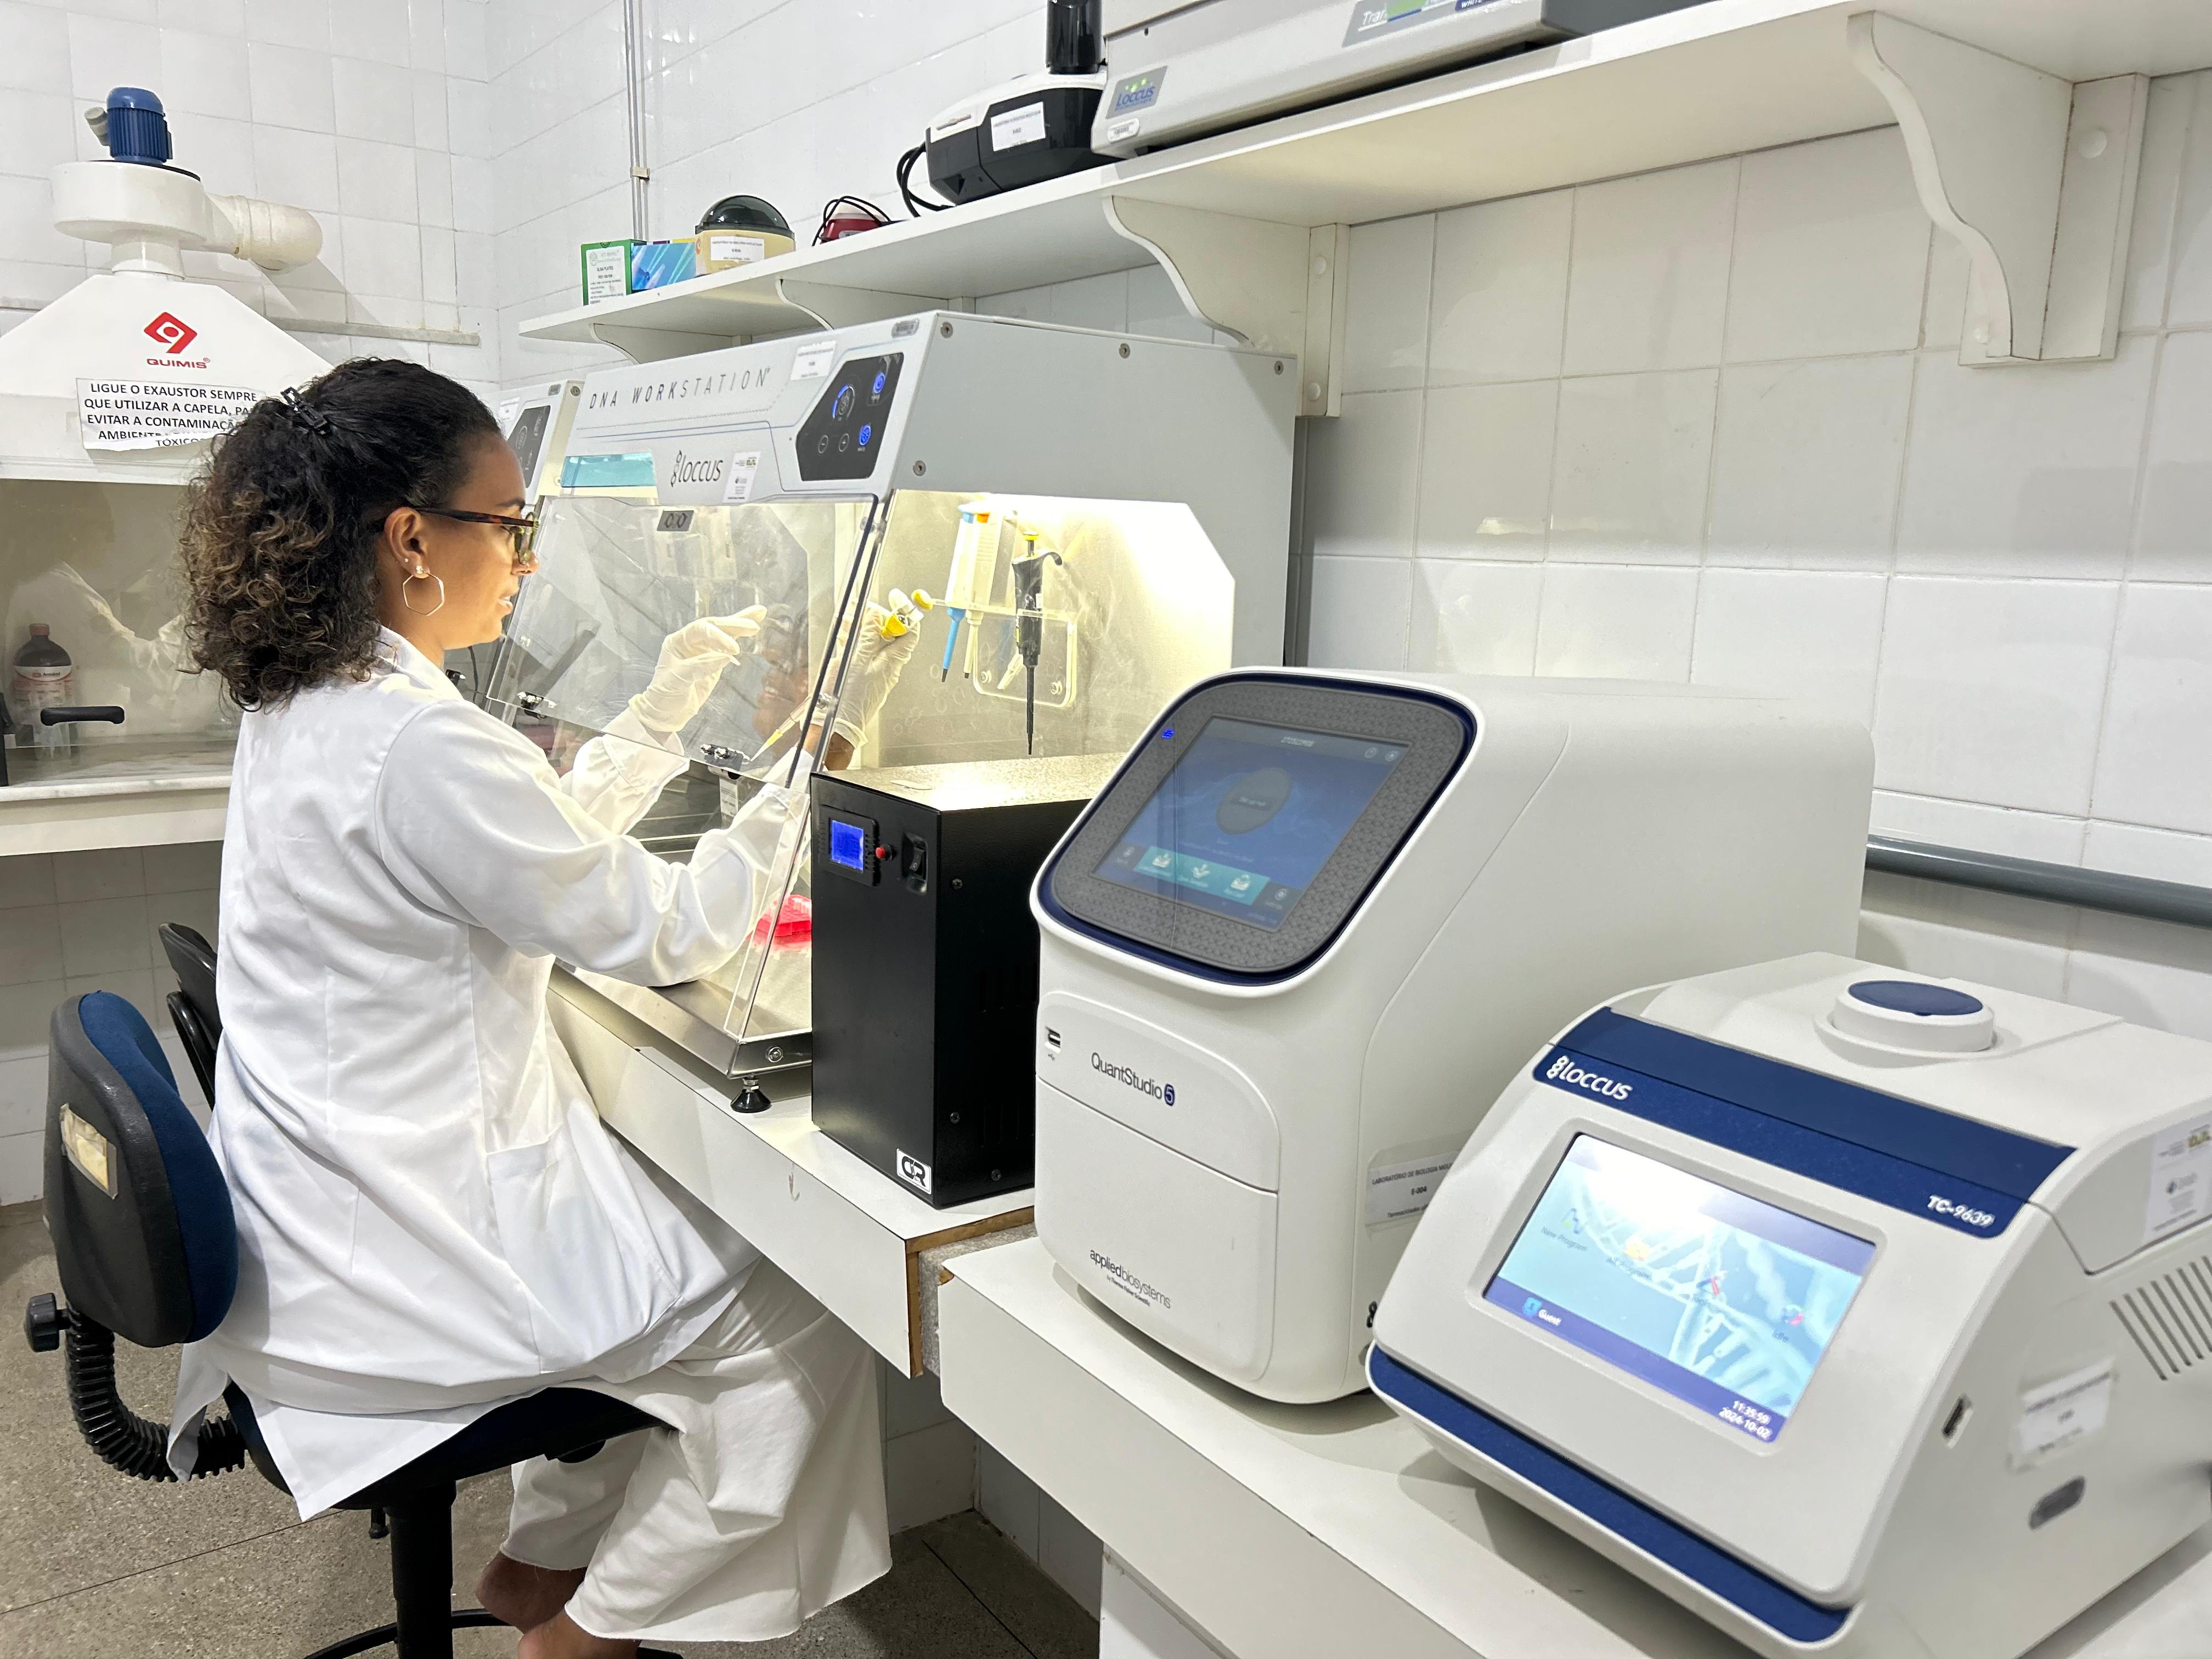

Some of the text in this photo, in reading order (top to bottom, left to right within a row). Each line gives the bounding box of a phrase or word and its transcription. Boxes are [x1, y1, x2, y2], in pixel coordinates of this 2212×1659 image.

[146, 358, 207, 369] QUIMIS
[91, 383, 257, 402] LIGUE O EXAUSTOR SEMPRE
[590, 369, 768, 409] DNA WORKSTATION
[84, 398, 249, 416] QUE UTILIZAR A CAPELA, PA
[87, 415, 235, 431] EVITAR A CONTAMINAÇÃ
[678, 455, 724, 483] loccus
[1091, 1052, 1175, 1107] QuantStudio 5
[1559, 1062, 1633, 1101] loccus
[1927, 1195, 1995, 1228] TC-9639
[1558, 1234, 1588, 1252] Program
[1090, 1250, 1171, 1308] appliedbiosystems
